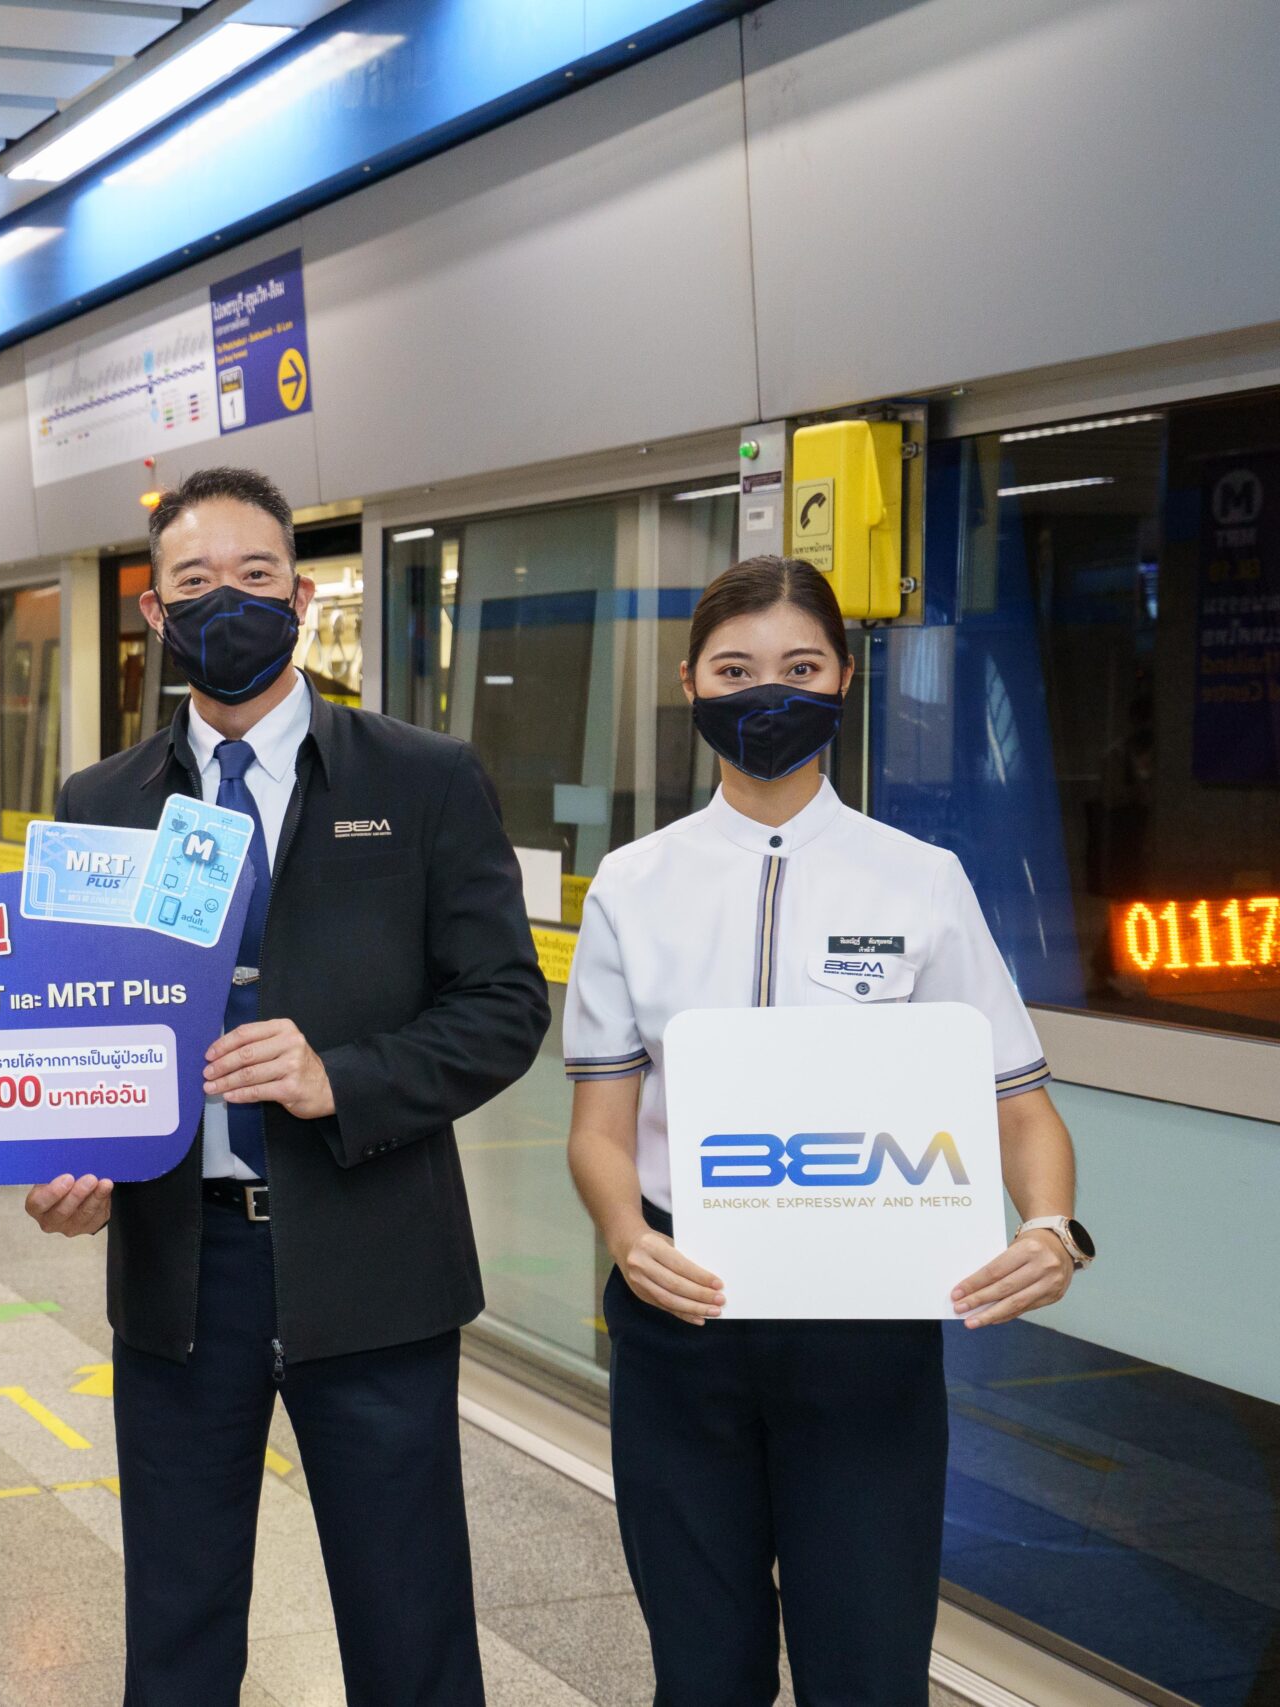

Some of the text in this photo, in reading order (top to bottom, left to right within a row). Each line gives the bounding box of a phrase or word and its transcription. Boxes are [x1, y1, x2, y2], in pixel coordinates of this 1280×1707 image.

[334, 819, 391, 833] BEM
[184, 834, 215, 861] M
[66, 850, 131, 875] MRT
[86, 876, 121, 889] PLUS
[181, 912, 204, 926] adult
[824, 960, 884, 974] BEM
[10, 992, 42, 1010] และ
[47, 981, 115, 1008] MRT
[123, 979, 187, 1006] Plus
[48, 1084, 147, 1107] บาทต่อวัน
[700, 1131, 971, 1188] BEM
[703, 1196, 972, 1209] BANGKOK EXPRESSWAY AND METRO
